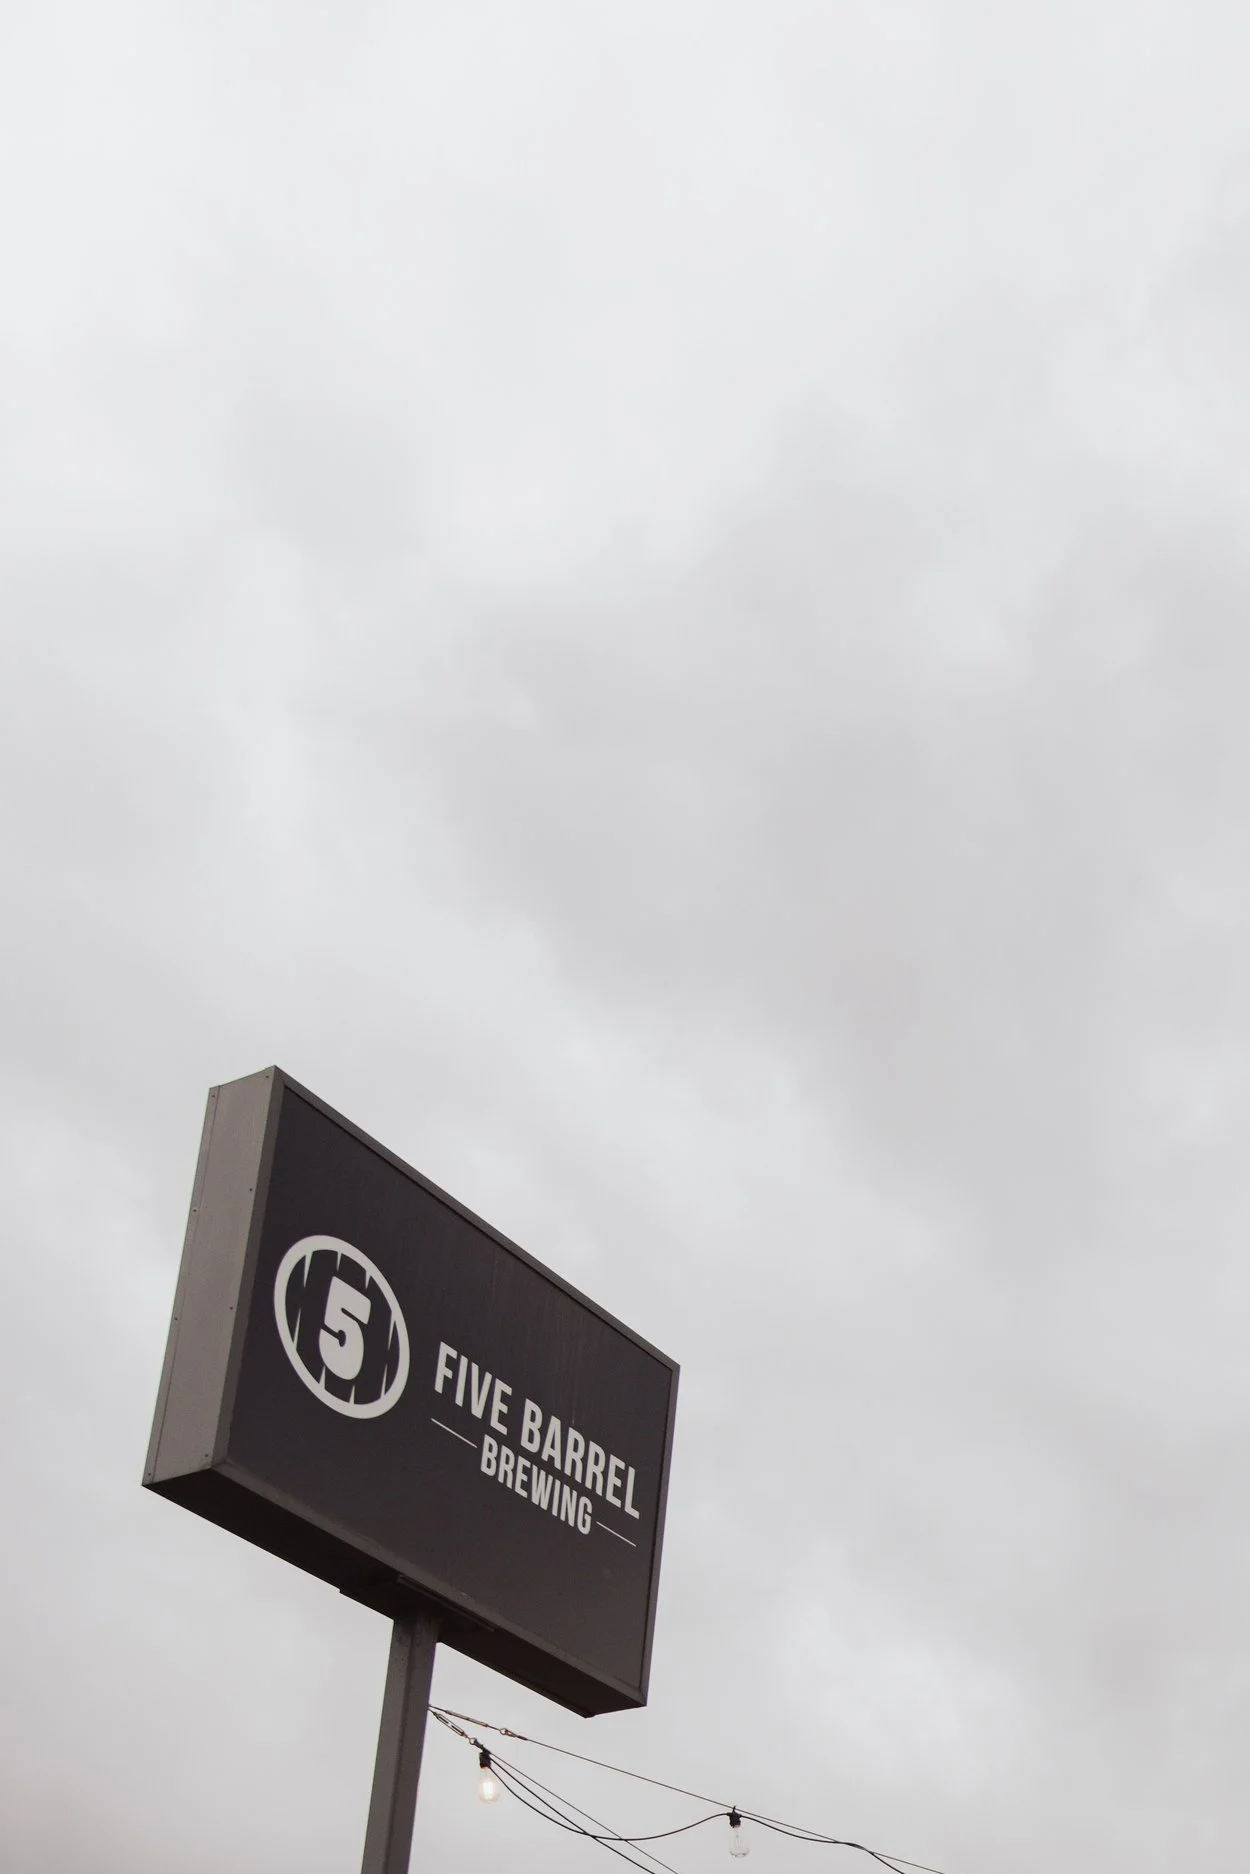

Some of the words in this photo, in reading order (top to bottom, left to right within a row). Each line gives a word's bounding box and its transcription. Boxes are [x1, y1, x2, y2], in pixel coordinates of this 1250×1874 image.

[318, 1275, 371, 1381] 5
[434, 1341, 513, 1436] FIVE
[520, 1398, 640, 1519] BARREL
[480, 1435, 593, 1535] BREWING
